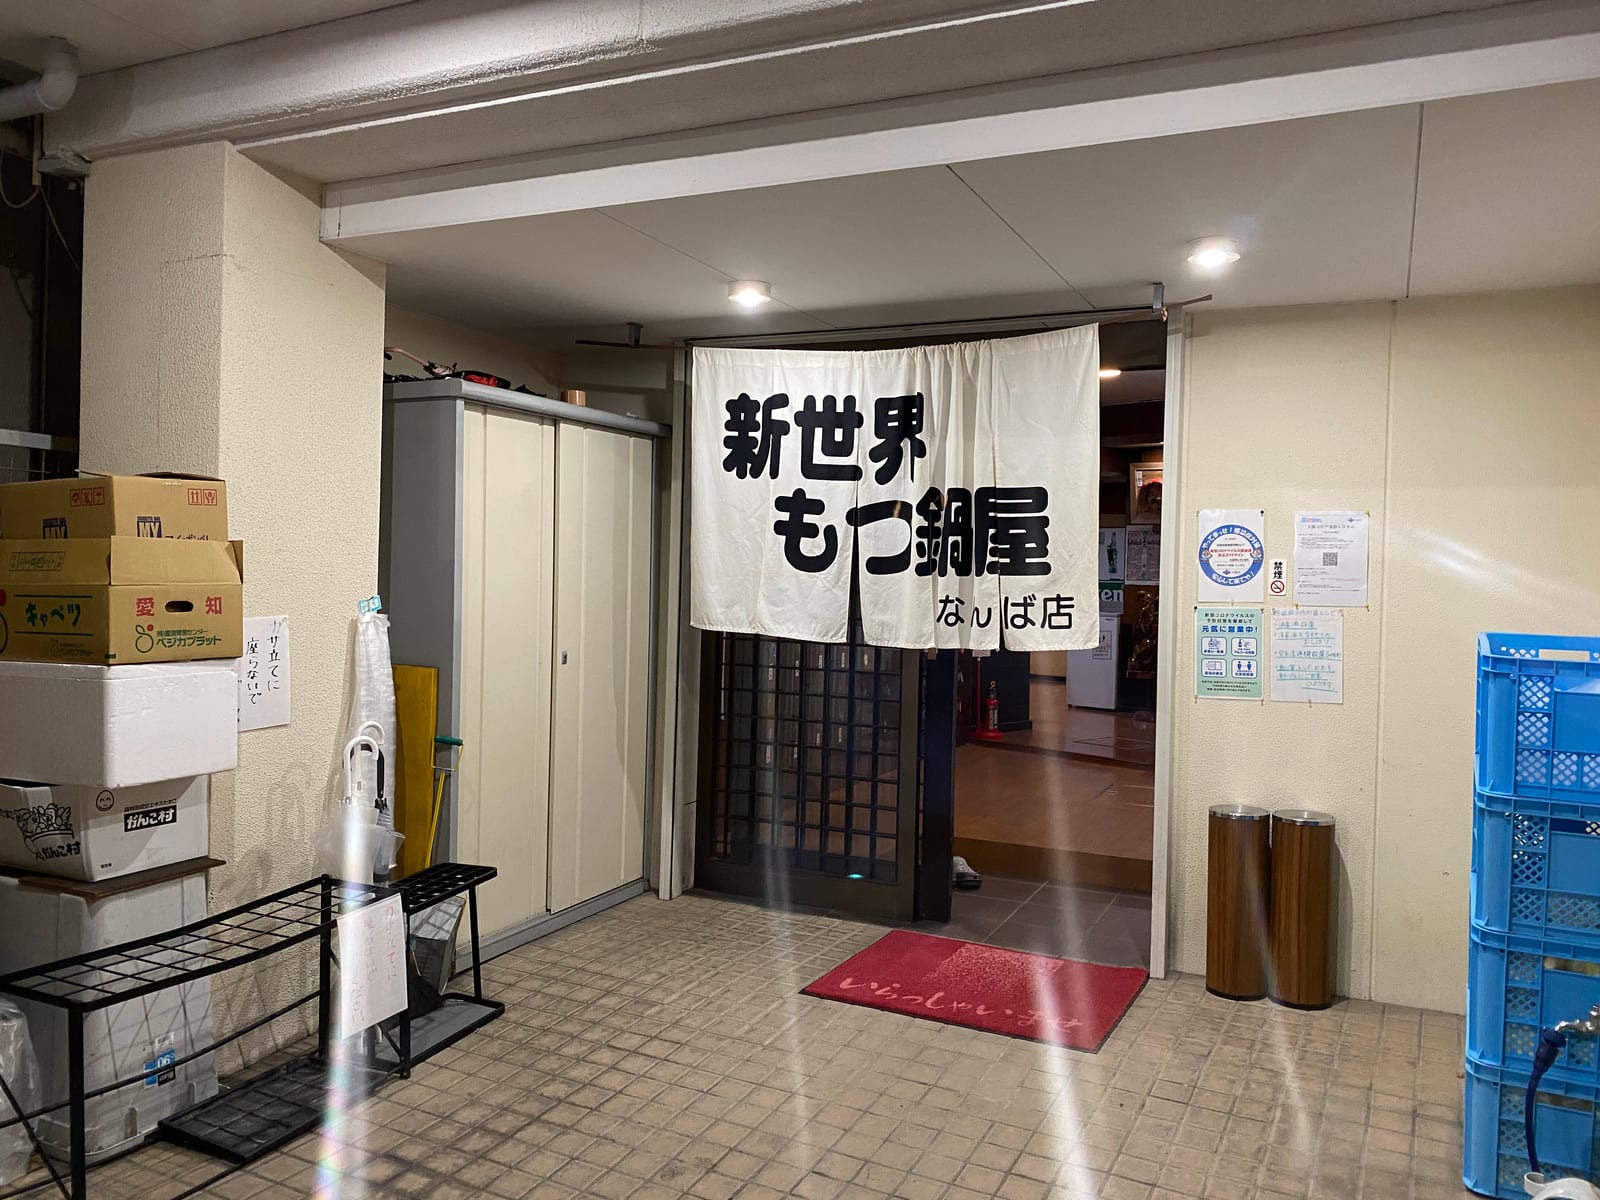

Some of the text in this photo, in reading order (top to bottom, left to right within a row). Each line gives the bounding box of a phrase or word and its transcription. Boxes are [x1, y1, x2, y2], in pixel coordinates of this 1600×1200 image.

[722, 391, 928, 486] 新世界
[773, 486, 1052, 577] もつ鍋屋
[1273, 561, 1283, 579] 禁煙
[25, 602, 81, 627] キャベツ
[136, 595, 223, 617] 愛 知
[936, 593, 1076, 630] なんば店
[246, 637, 262, 705] 座らないで
[126, 807, 175, 830] がんこ村
